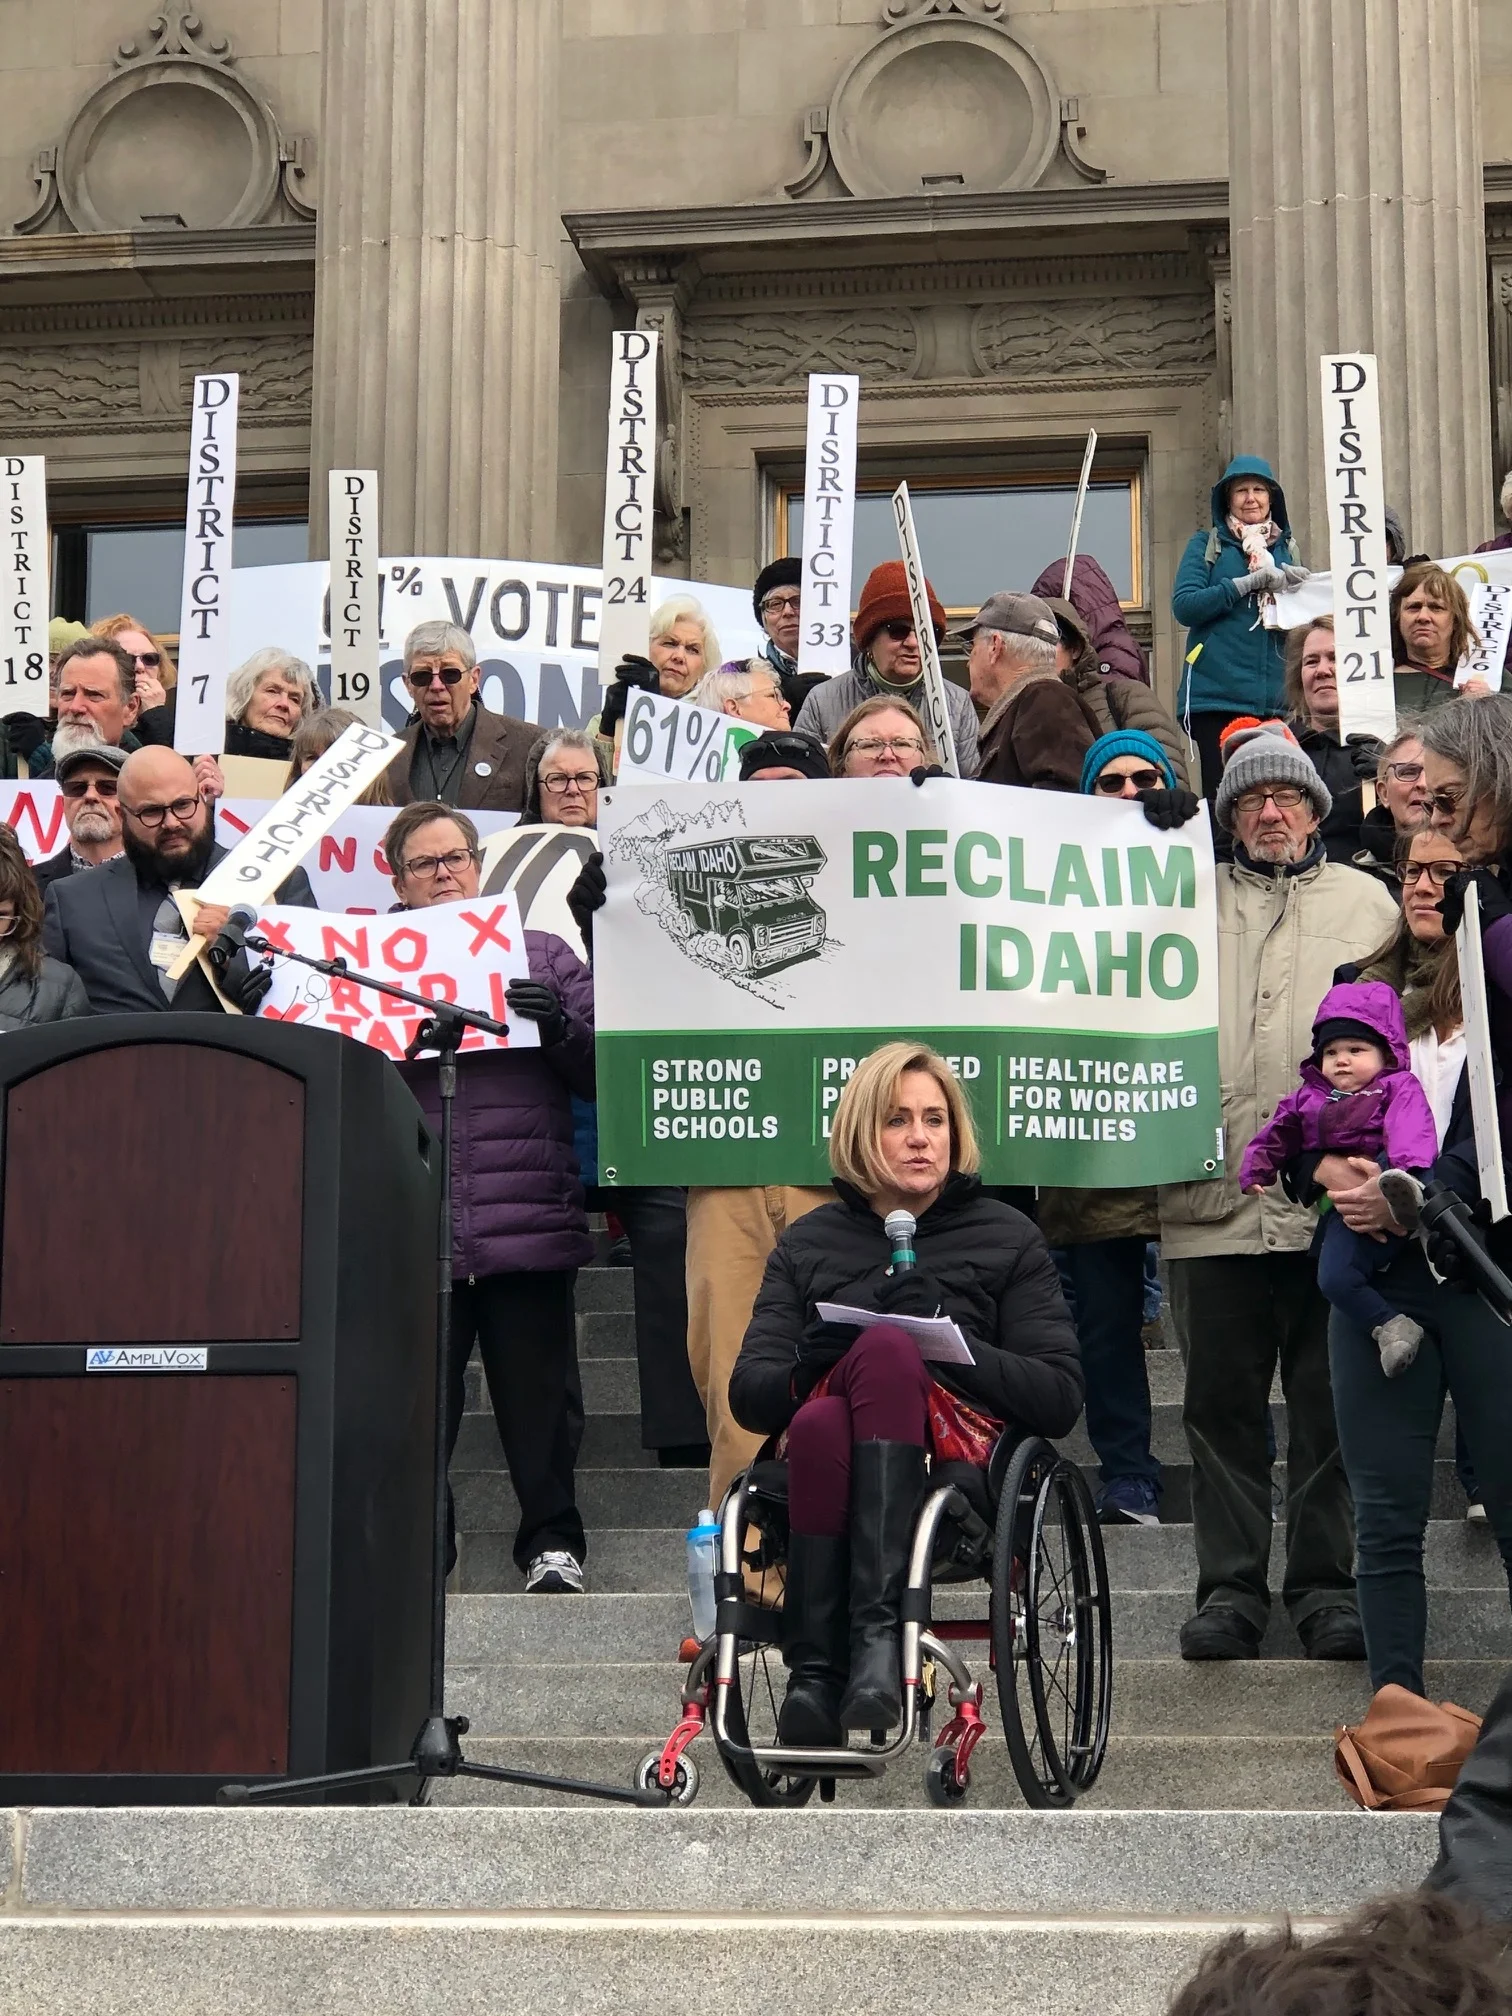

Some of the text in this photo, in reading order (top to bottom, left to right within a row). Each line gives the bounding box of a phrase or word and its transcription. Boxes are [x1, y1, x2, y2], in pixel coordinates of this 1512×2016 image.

[608, 332, 650, 604] DISTRICT 24
[191, 378, 230, 705] DISTRICT 7
[806, 384, 848, 647] DISRTICT 33
[1331, 362, 1384, 682] DISTRICT 21
[4, 457, 43, 685] DISTRICT 18
[322, 566, 422, 639] 1%
[337, 476, 370, 701] DISTRICT 19
[894, 494, 949, 764] DISTRICT
[1472, 585, 1511, 671] DISTRICT 6
[627, 696, 721, 783] 61%
[256, 728, 389, 862] DISTRICT
[236, 866, 262, 882] 9
[668, 845, 736, 873] RECLAIM IDAHO
[852, 829, 1197, 908] RECLAIM
[321, 926, 428, 973] NO
[959, 923, 1199, 1000] IDAHO
[652, 1058, 762, 1083] STRONG
[652, 1088, 750, 1111] PUBLIC
[1008, 1056, 1184, 1084] HEALTHCARE
[1008, 1085, 1198, 1113] FOR WORKING
[652, 1115, 778, 1139] SCHOOLS
[1008, 1115, 1137, 1142] FAMILIES
